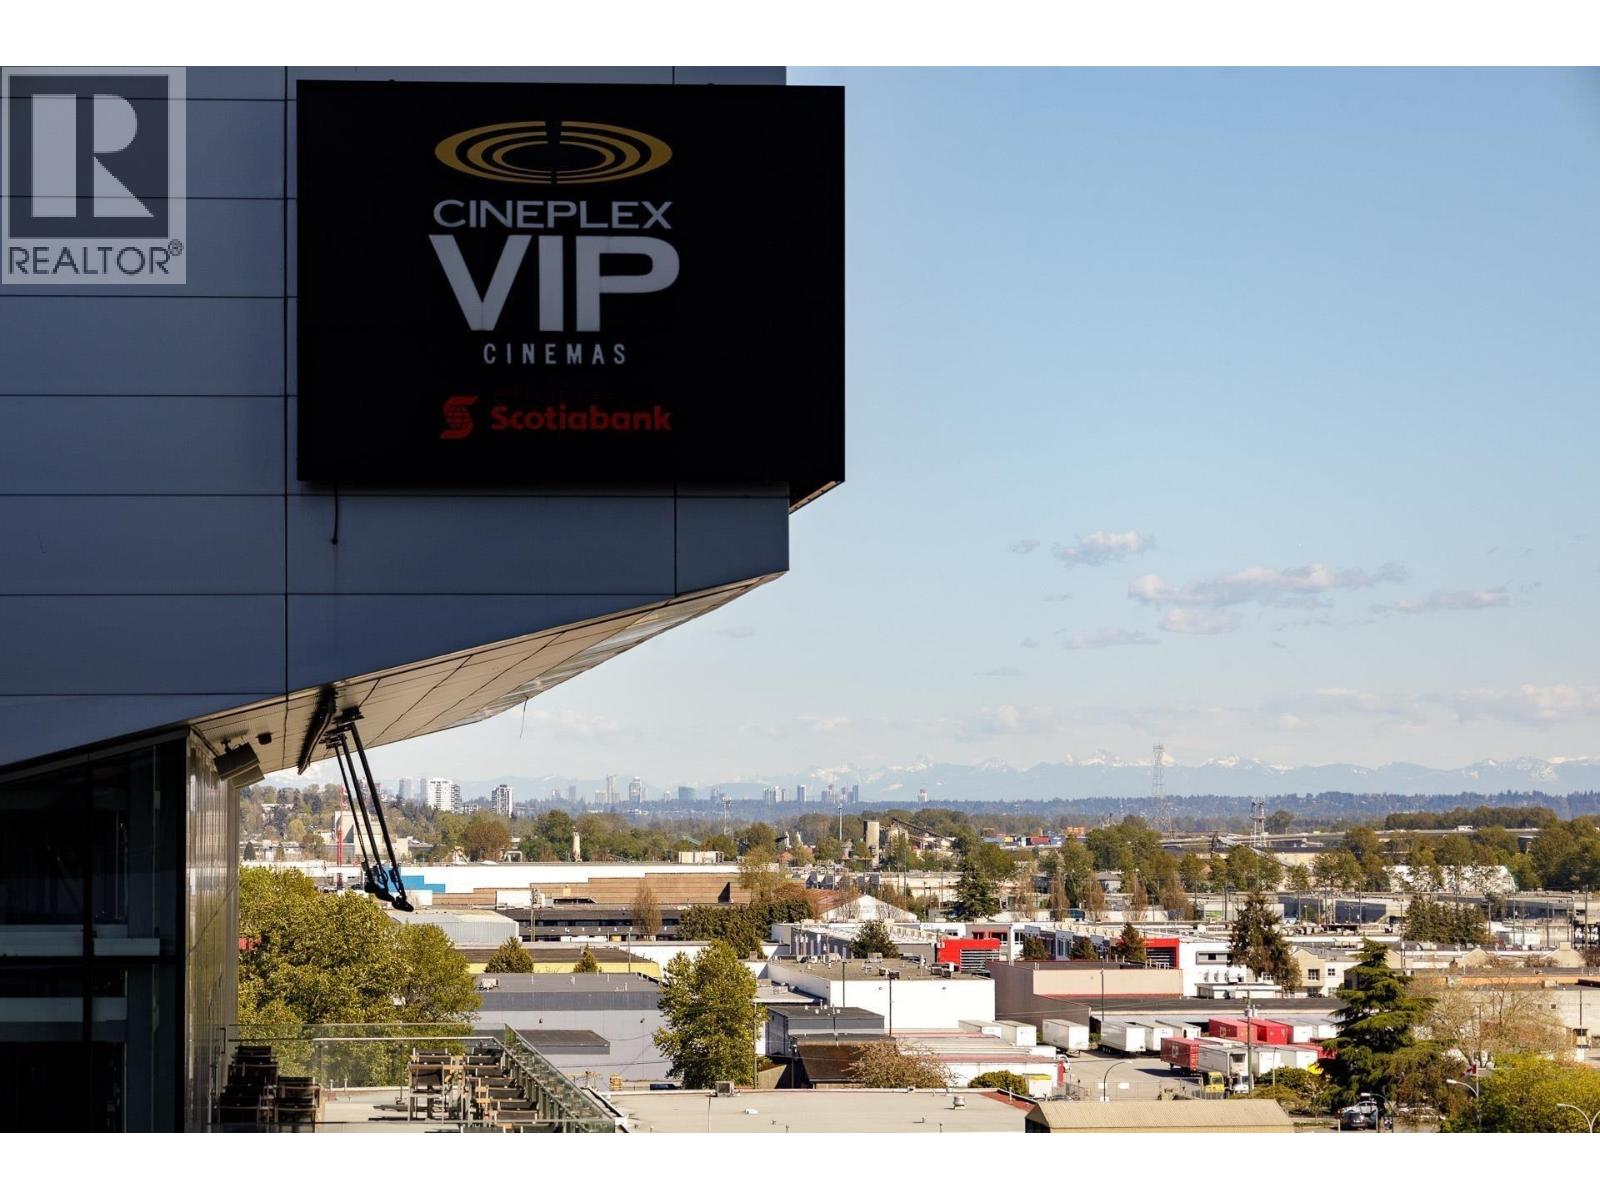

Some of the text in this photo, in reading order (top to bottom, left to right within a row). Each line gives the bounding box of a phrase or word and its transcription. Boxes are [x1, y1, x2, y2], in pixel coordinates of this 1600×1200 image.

[433, 199, 673, 229] CINEPLEX
[428, 234, 680, 332] VIP
[483, 343, 626, 365] CINEMAS
[491, 404, 672, 431] Scotiabank
